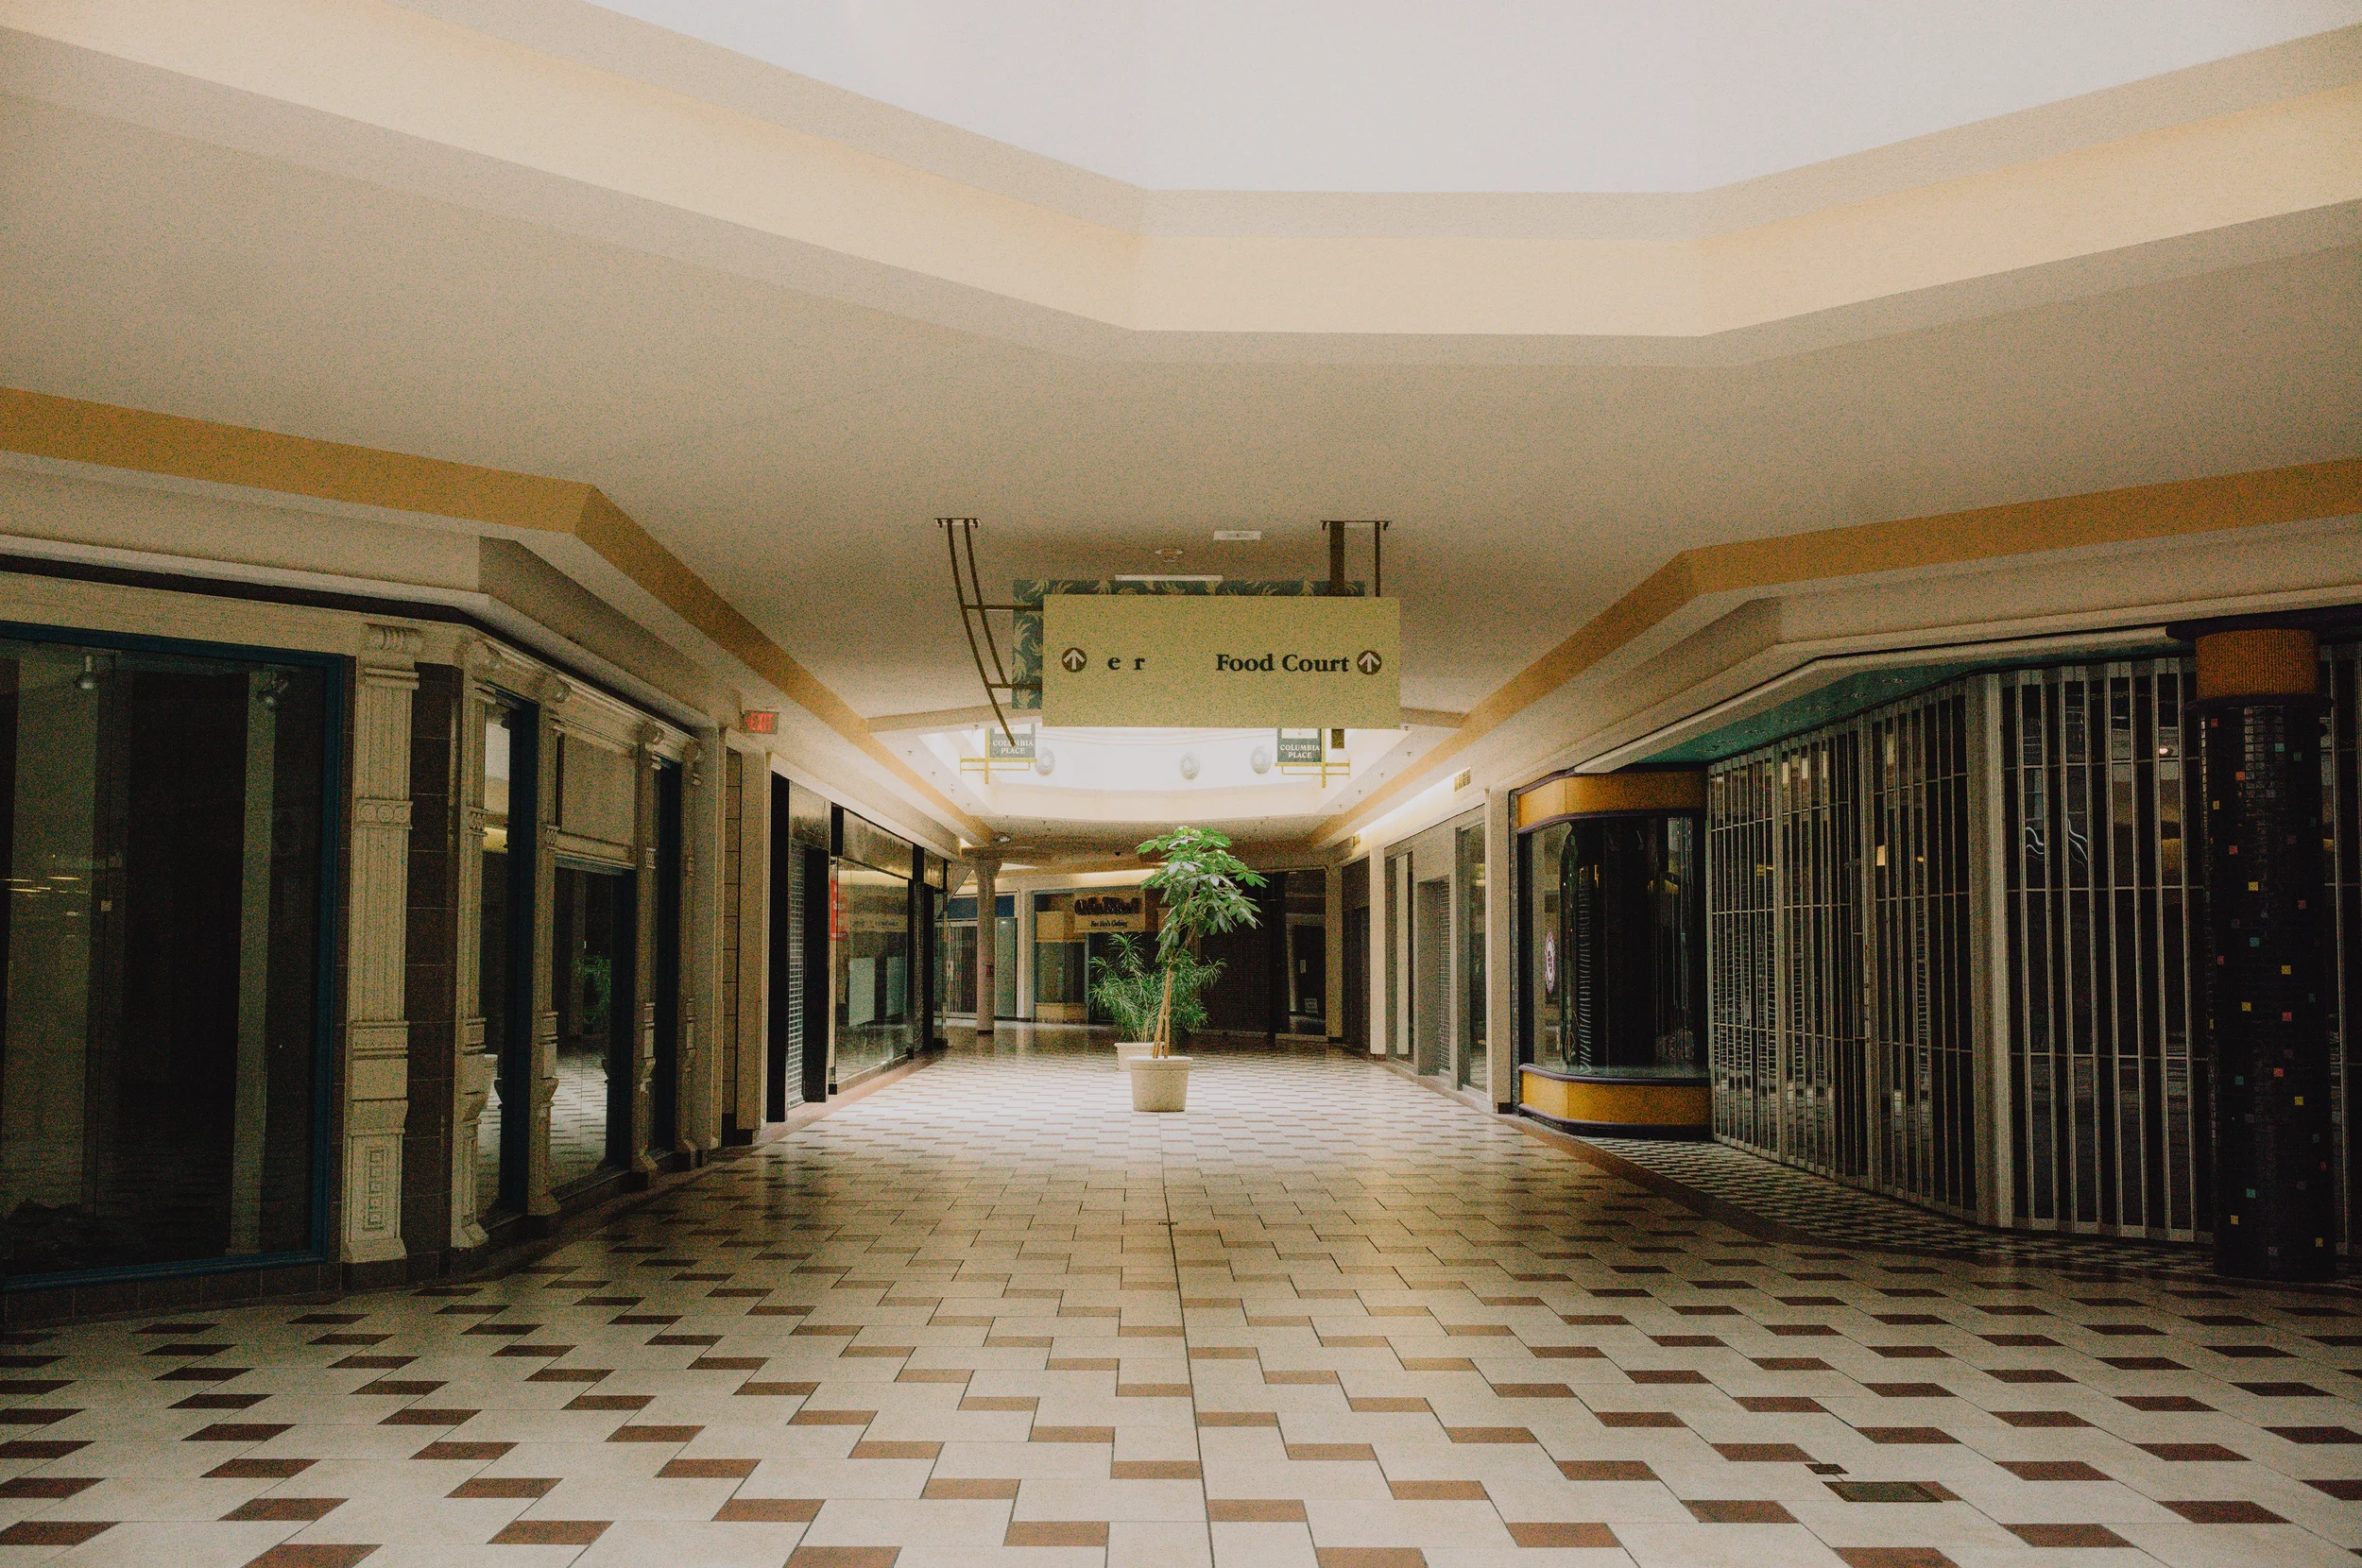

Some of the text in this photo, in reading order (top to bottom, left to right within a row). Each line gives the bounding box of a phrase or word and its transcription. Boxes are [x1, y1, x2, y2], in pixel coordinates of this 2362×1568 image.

[1215, 653, 1350, 673] Food Court
[750, 711, 774, 732] EXIT
[1279, 743, 1321, 752] COLUMBIA
